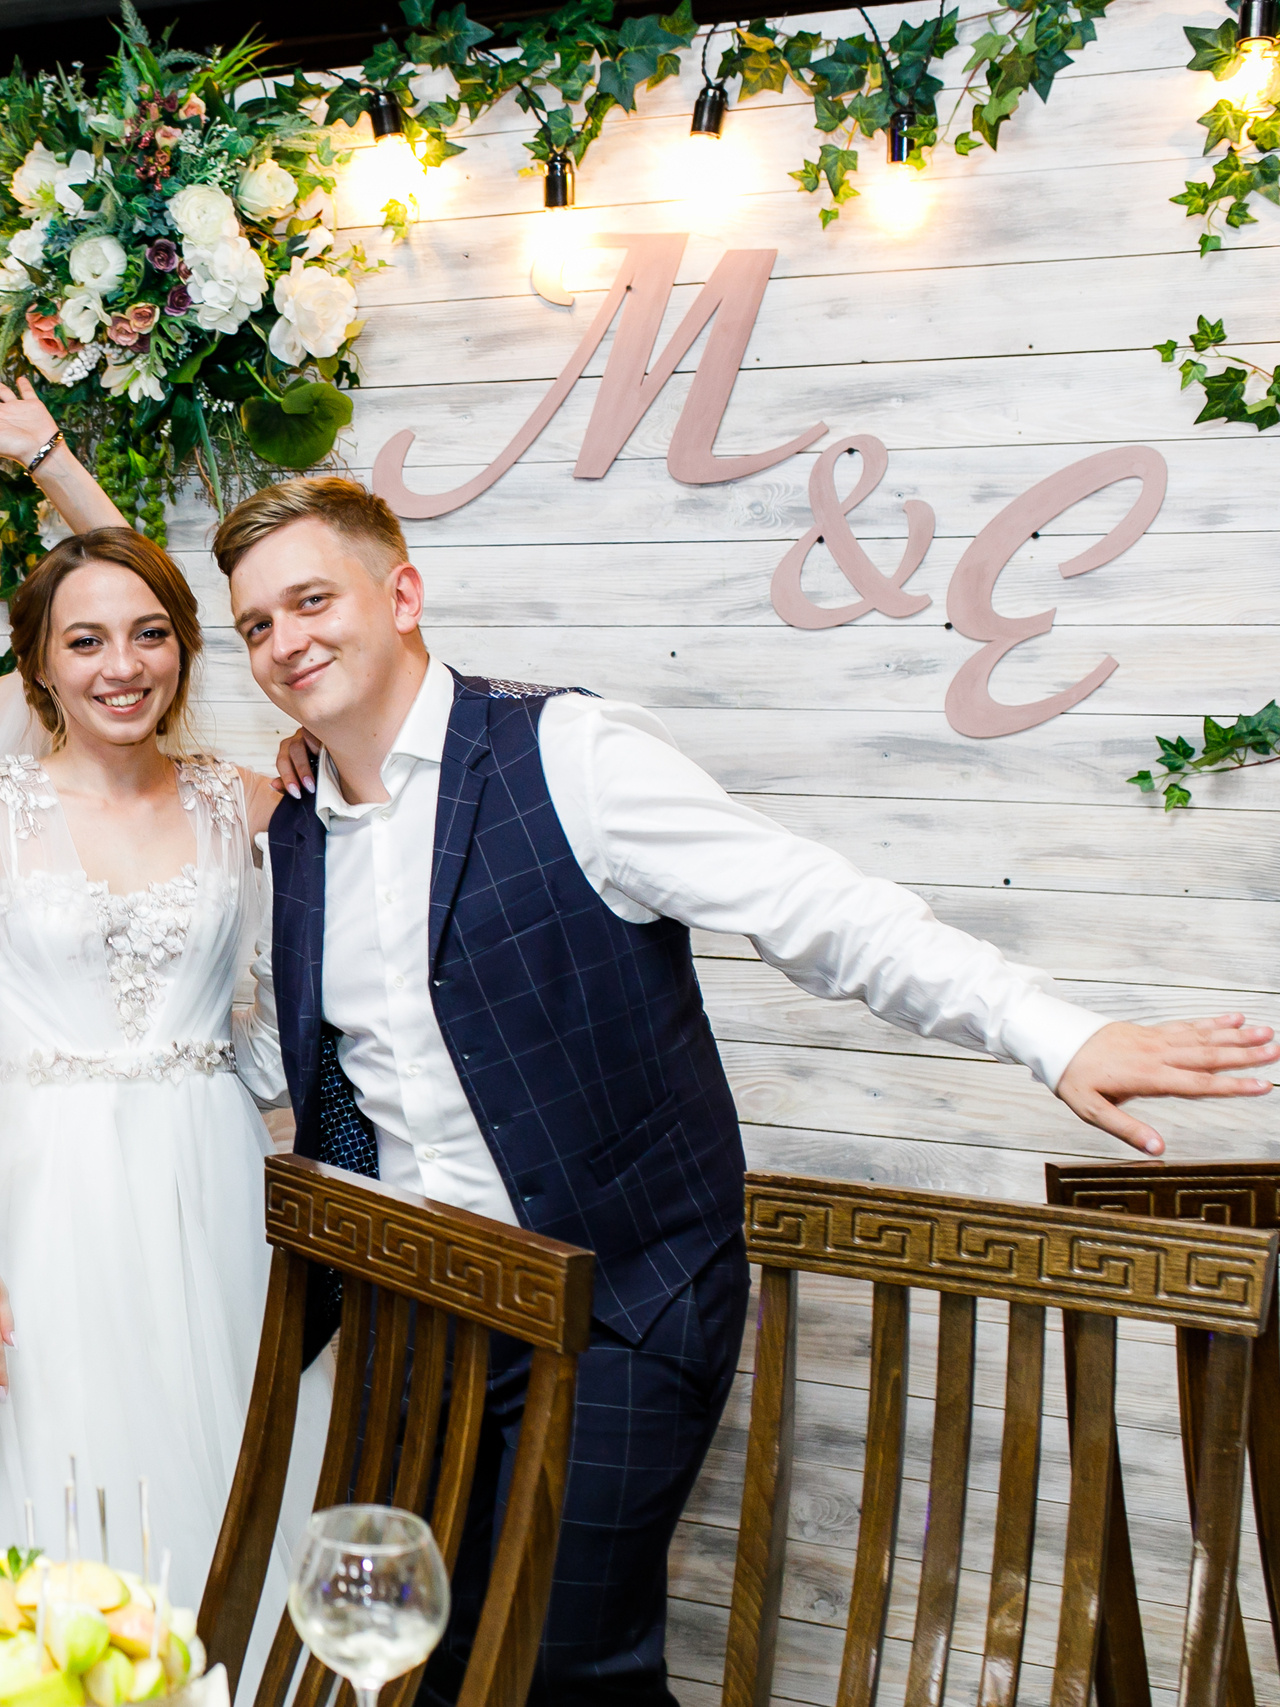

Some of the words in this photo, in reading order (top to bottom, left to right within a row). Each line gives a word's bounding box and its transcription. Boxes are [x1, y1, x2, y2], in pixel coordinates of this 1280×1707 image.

[373, 232, 829, 520] M
[771, 434, 936, 630] &
[945, 445, 1168, 739] E
